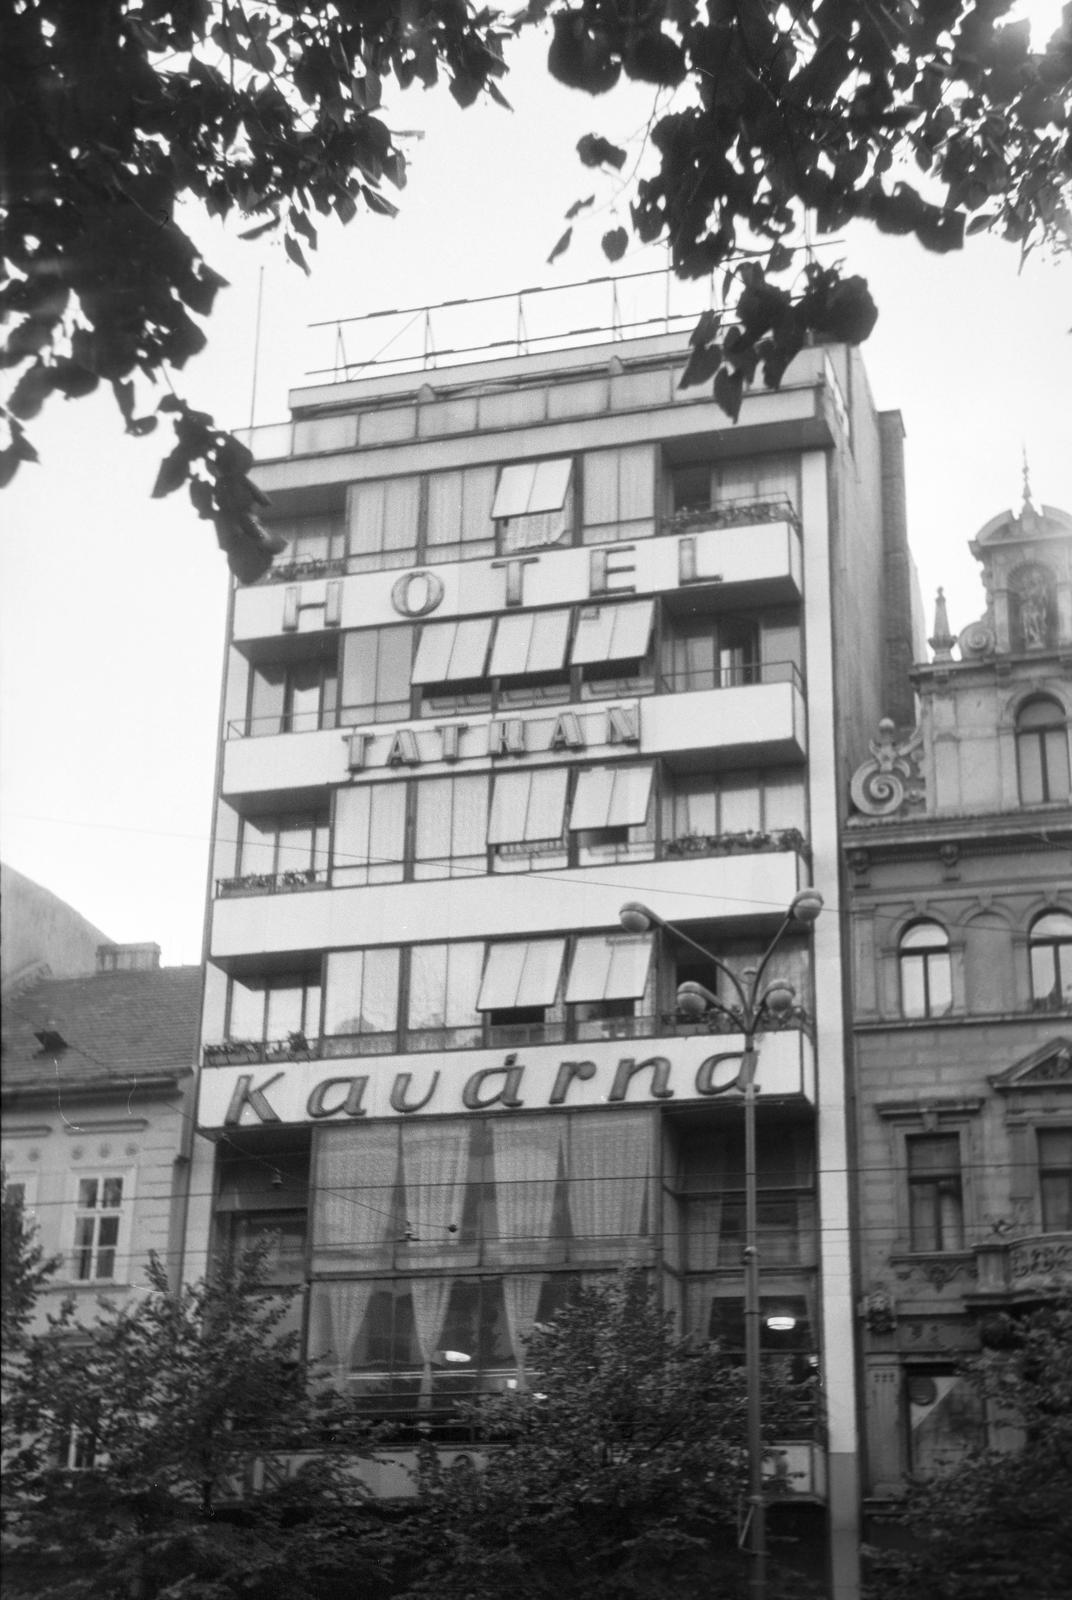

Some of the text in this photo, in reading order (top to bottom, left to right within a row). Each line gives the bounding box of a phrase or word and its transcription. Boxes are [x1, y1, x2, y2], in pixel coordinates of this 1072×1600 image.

[282, 537, 723, 632] HOTEL
[342, 705, 640, 772] TATRAN
[224, 1051, 761, 1126] Kavárna
